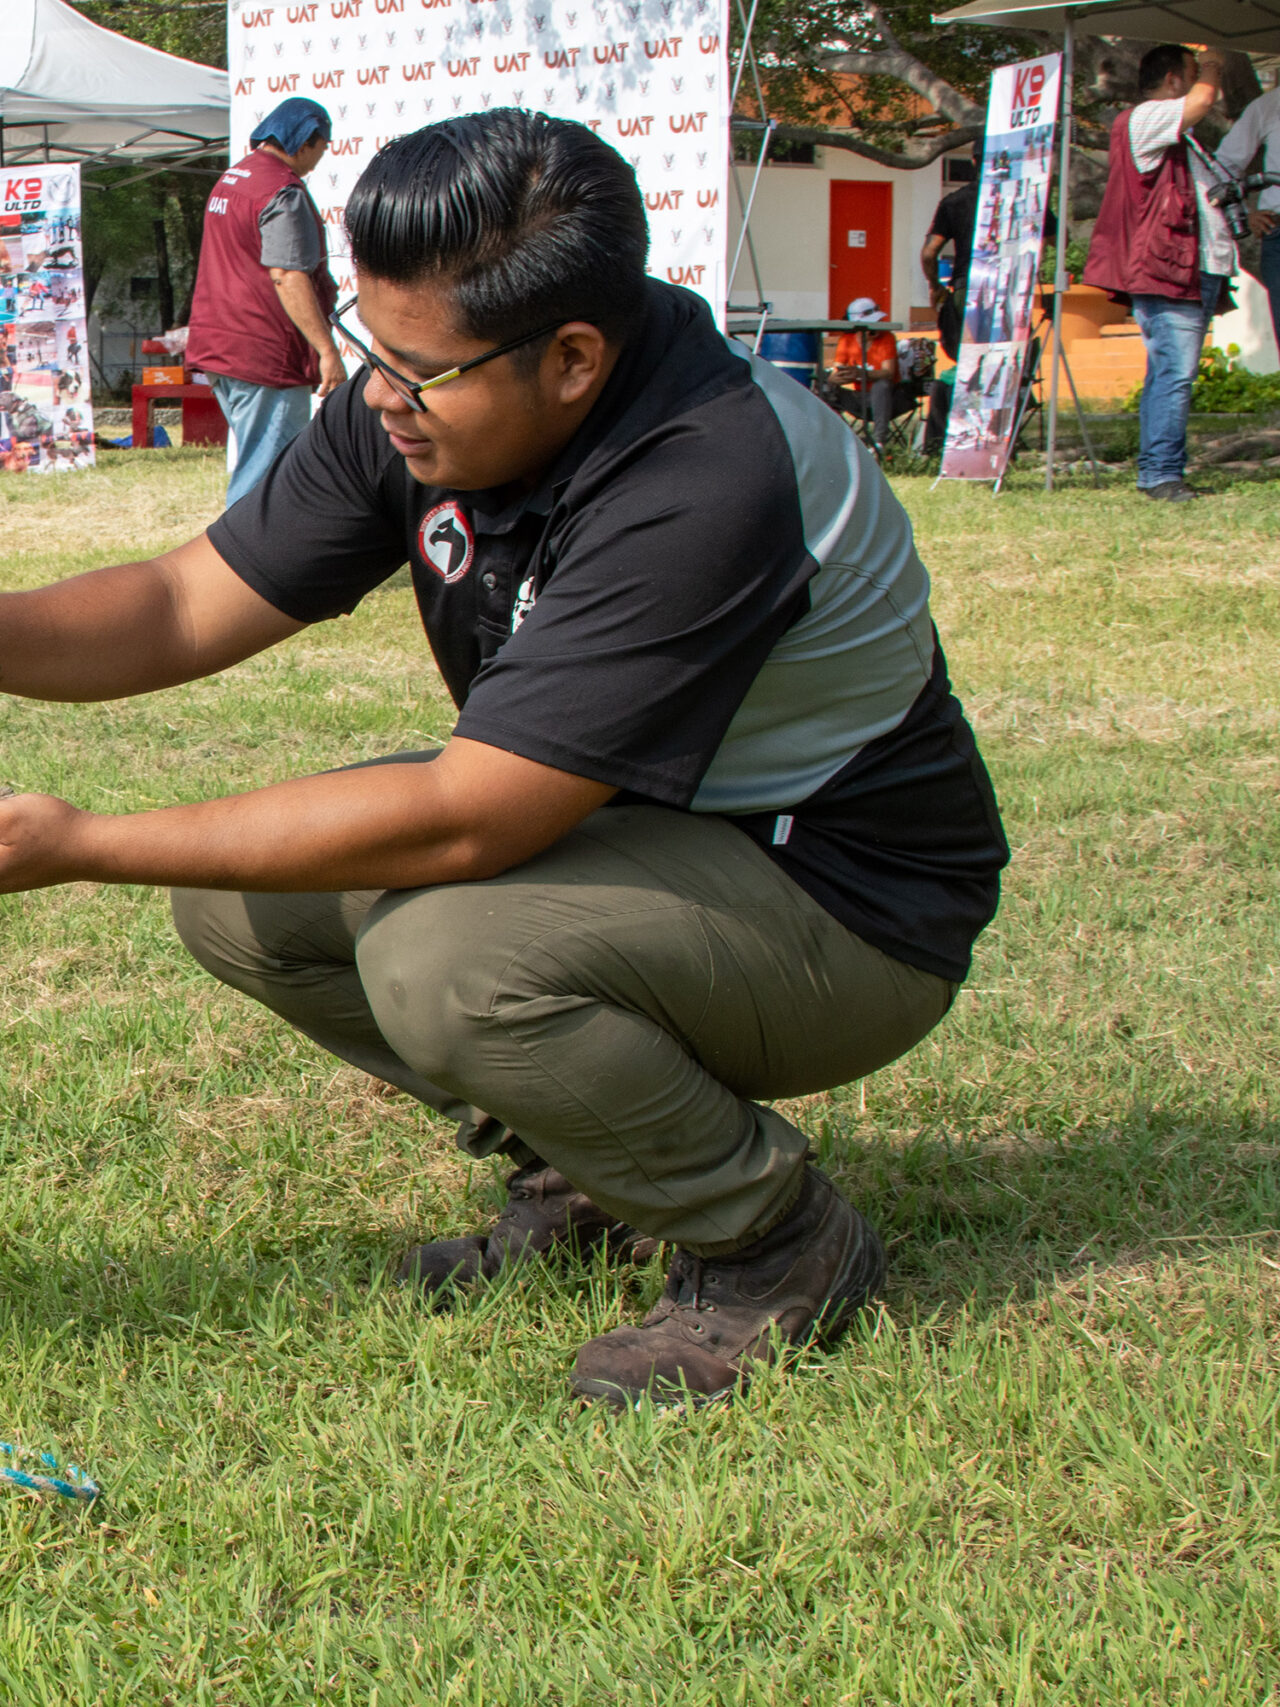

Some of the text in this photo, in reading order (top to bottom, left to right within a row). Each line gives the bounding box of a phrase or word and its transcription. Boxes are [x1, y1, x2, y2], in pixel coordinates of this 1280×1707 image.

[242, 9, 275, 28] UAT
[286, 4, 319, 23] UAT
[331, 0, 363, 19] UAT
[235, 34, 720, 96] AT UAT UAT UAT UAT UAT UAT UAT UAT UAT UA
[330, 137, 363, 156] UAT
[617, 116, 654, 136] UAT
[669, 112, 708, 134] UAT
[4, 200, 42, 212] ULTD
[208, 196, 228, 215] UAT
[644, 190, 684, 210] UAT
[696, 187, 720, 208] UA
[667, 265, 706, 285] UAT
